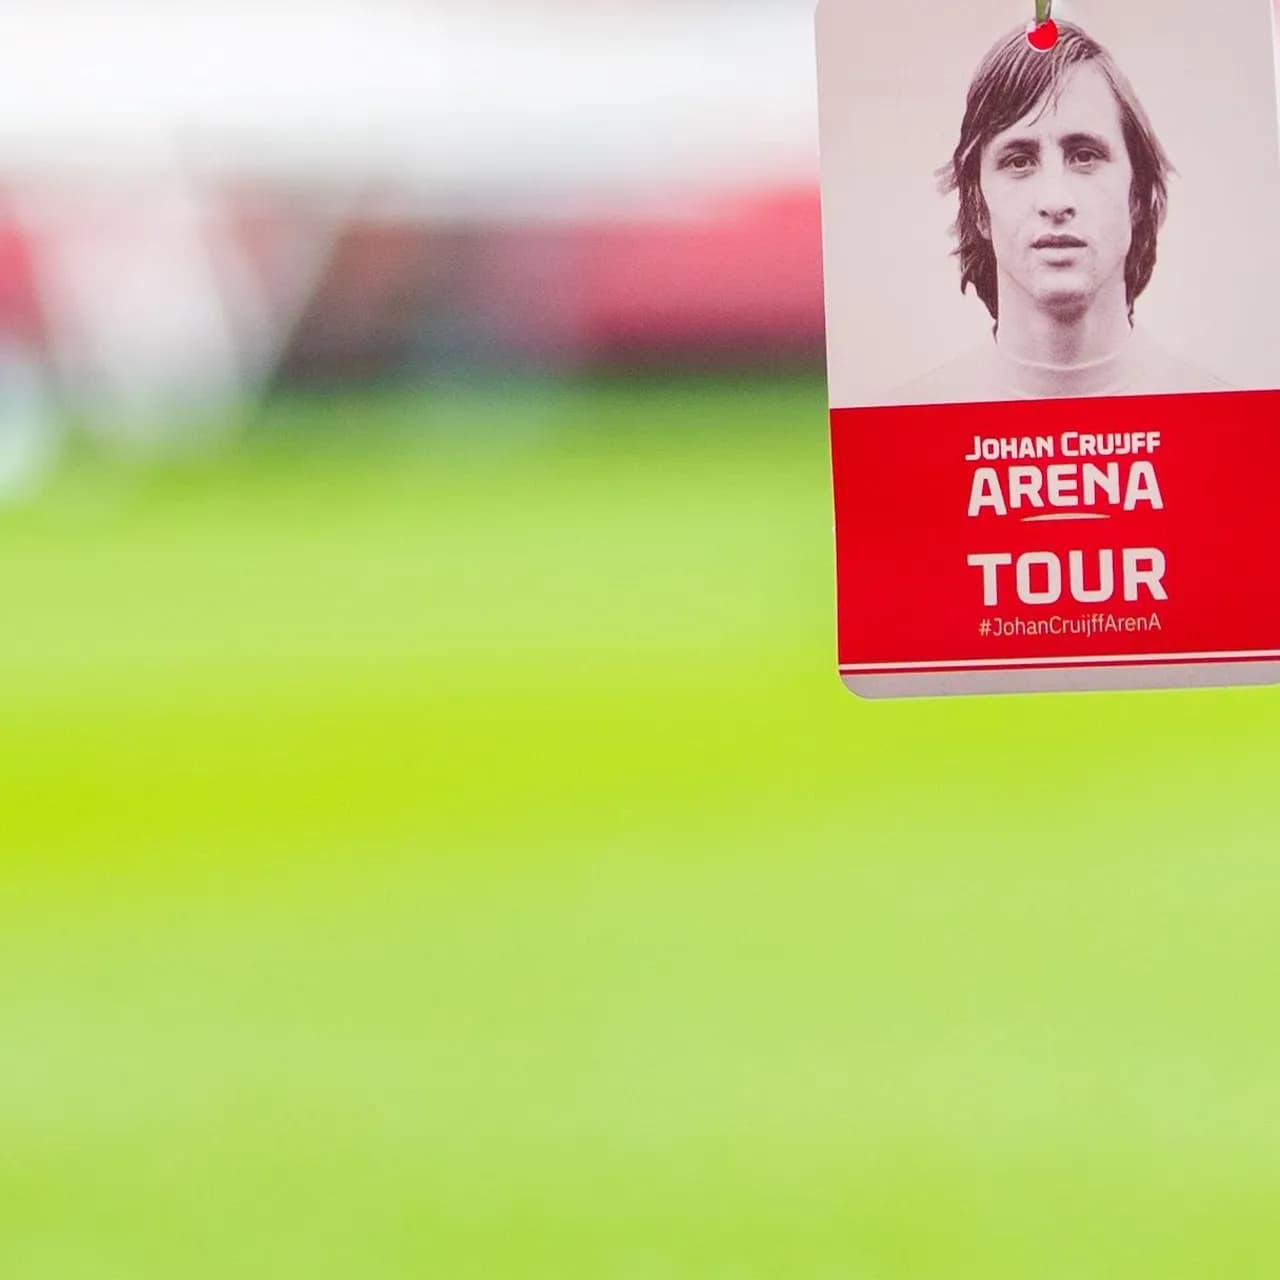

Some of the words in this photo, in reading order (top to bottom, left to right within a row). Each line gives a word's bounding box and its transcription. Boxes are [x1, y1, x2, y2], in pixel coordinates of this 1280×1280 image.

[964, 435, 1054, 461] JOHAN
[967, 461, 1164, 517] ARENA
[966, 547, 1169, 607] TOUR
[979, 613, 1162, 638] #JohanCruijffArenA
